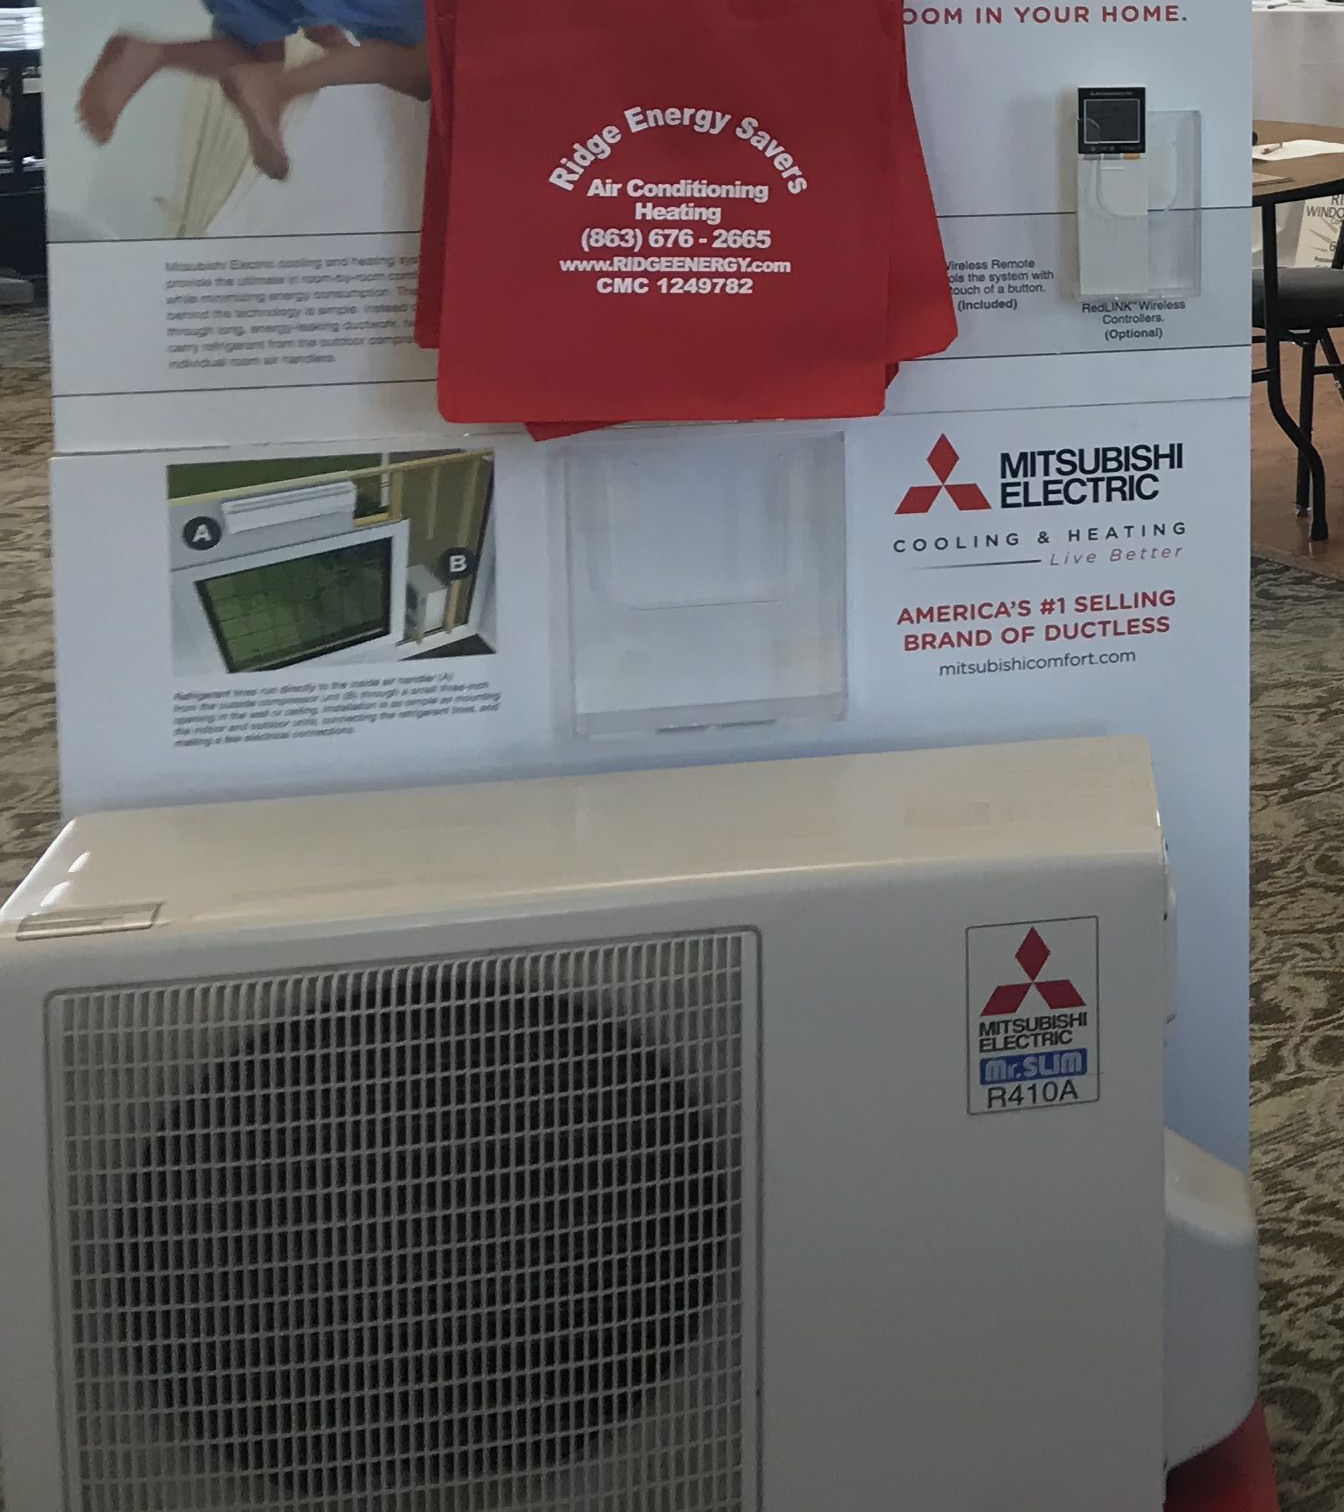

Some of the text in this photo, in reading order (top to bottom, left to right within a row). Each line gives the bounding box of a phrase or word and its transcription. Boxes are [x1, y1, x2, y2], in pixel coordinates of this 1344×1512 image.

[976, 5, 1188, 25] IN YOUR HOME.
[549, 106, 808, 195] Ridge Energy Savers
[587, 178, 769, 203] Air Conditioning
[635, 201, 722, 225] Heating
[580, 228, 771, 251] (863) 676 2665
[559, 256, 791, 275] www.RIDGEENERGY.com
[991, 259, 1036, 269] Remote
[596, 277, 753, 294] CMC 1249782
[968, 272, 985, 282] the
[988, 271, 1029, 283] system
[1032, 270, 1054, 280] with
[983, 284, 1046, 294] of a button.
[957, 299, 1018, 312] (Included)
[1138, 300, 1186, 310] Wireless
[1102, 313, 1165, 324] Controllers.
[1104, 328, 1163, 341] (Optional)
[1000, 442, 1183, 479] MITSUBISHI
[1000, 473, 1160, 509] ELECTRIC
[191, 524, 213, 545] A
[893, 522, 1186, 554] COOLING & HEATING
[449, 555, 469, 573] B
[1050, 545, 1184, 566] Live Better
[897, 589, 1177, 626] AMERICA'S #1 SELLING
[903, 615, 1171, 652] BRAND OF DUCTLESS
[938, 650, 1137, 677] mitsubishicomfort.com
[979, 1011, 1088, 1037] MITSUBISHI
[979, 1030, 1073, 1054] ELECTRIC
[987, 1079, 1079, 1109] R410A
